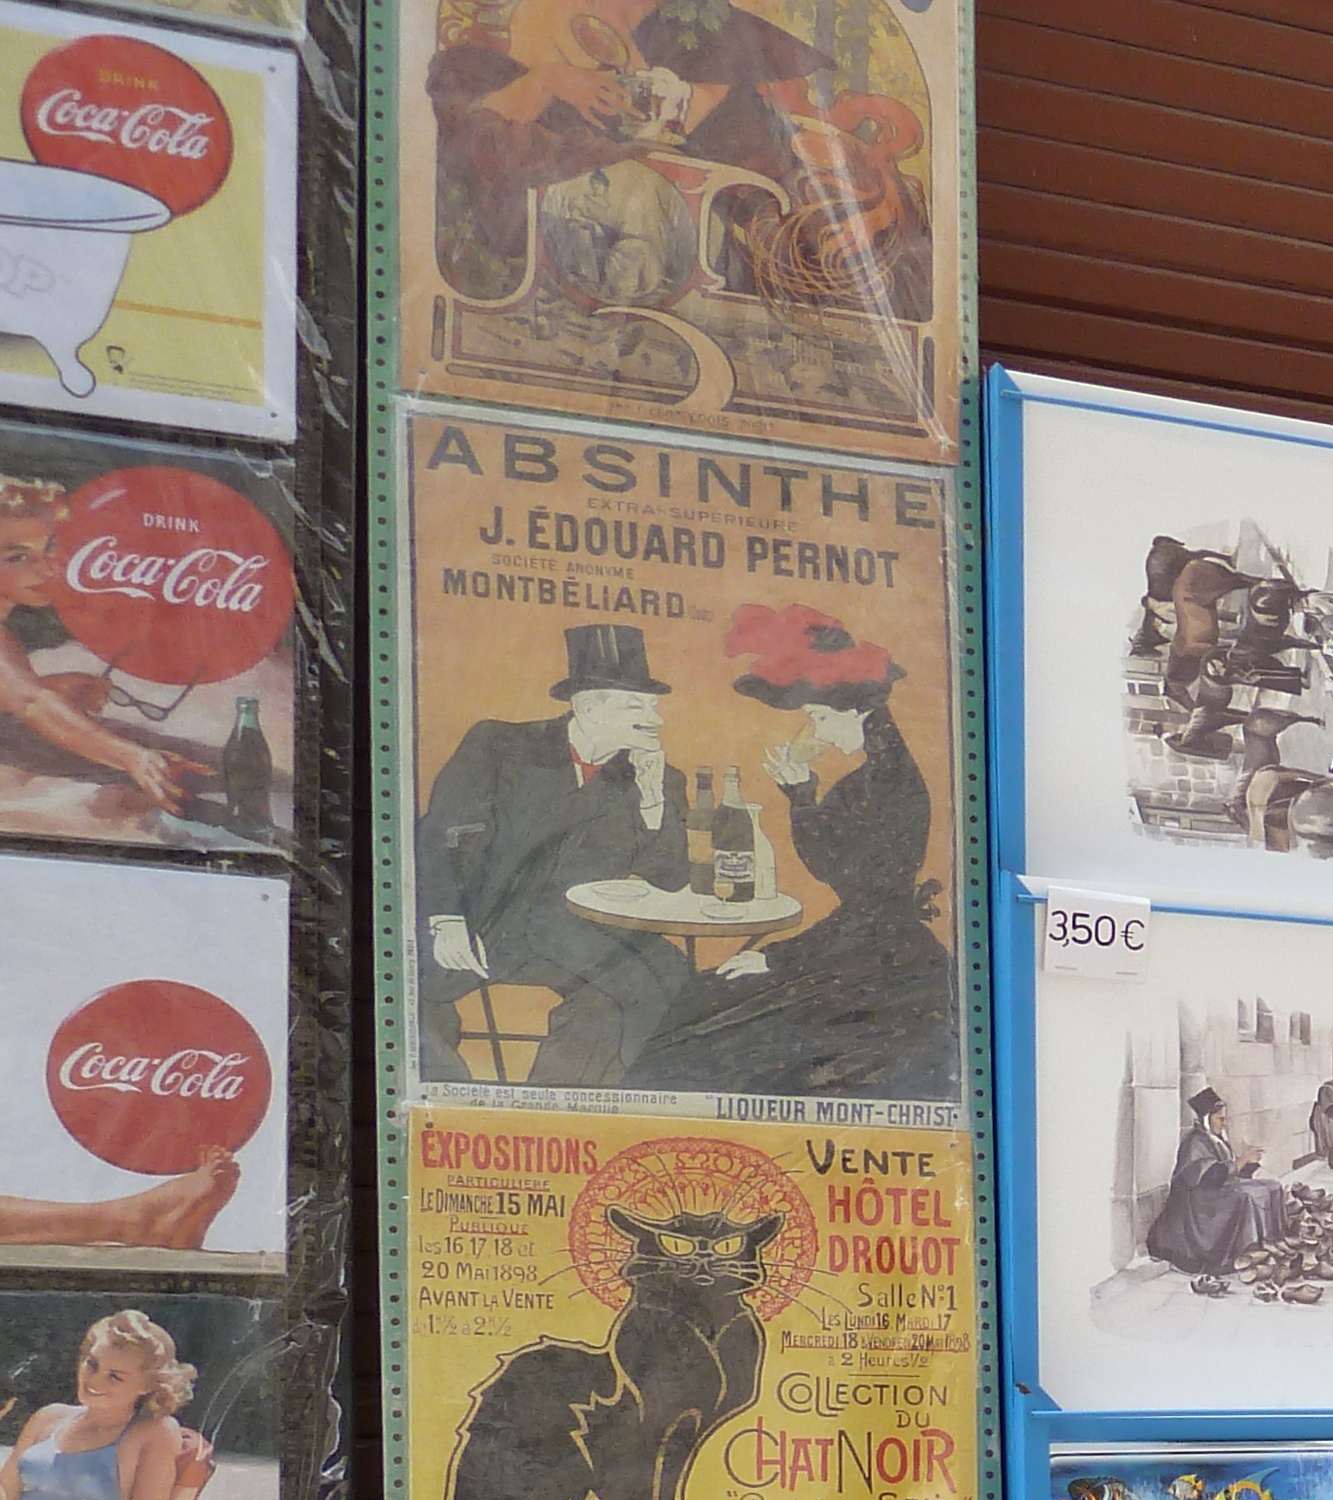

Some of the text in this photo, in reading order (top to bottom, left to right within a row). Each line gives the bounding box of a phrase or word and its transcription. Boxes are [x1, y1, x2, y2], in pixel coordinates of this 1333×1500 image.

[36, 88, 214, 160] Coca-Cola
[426, 425, 937, 530] ABSINTHE
[143, 510, 200, 535] DRINK
[478, 505, 900, 589] J. ÉDOUARD PERNOT
[66, 534, 271, 614] Coca-Cola
[442, 567, 686, 620] MONTBÉLIARD
[58, 1042, 251, 1101] Coca-Cola
[421, 1129, 598, 1176] EXPOSITIONS
[805, 1137, 938, 1179] VENTE
[434, 1188, 495, 1215] DIMANCHE
[495, 1190, 522, 1216] 15
[526, 1193, 566, 1219] MAI
[449, 1215, 530, 1236] PUBLIQUE
[827, 1177, 953, 1229] HÔTEL
[828, 1234, 962, 1277] DROUOT
[418, 1286, 555, 1311] AVANT LA VENTE
[776, 1371, 949, 1419] COLLECTION
[895, 1409, 931, 1429] DU
[723, 1415, 960, 1495] CHAT NOIR
